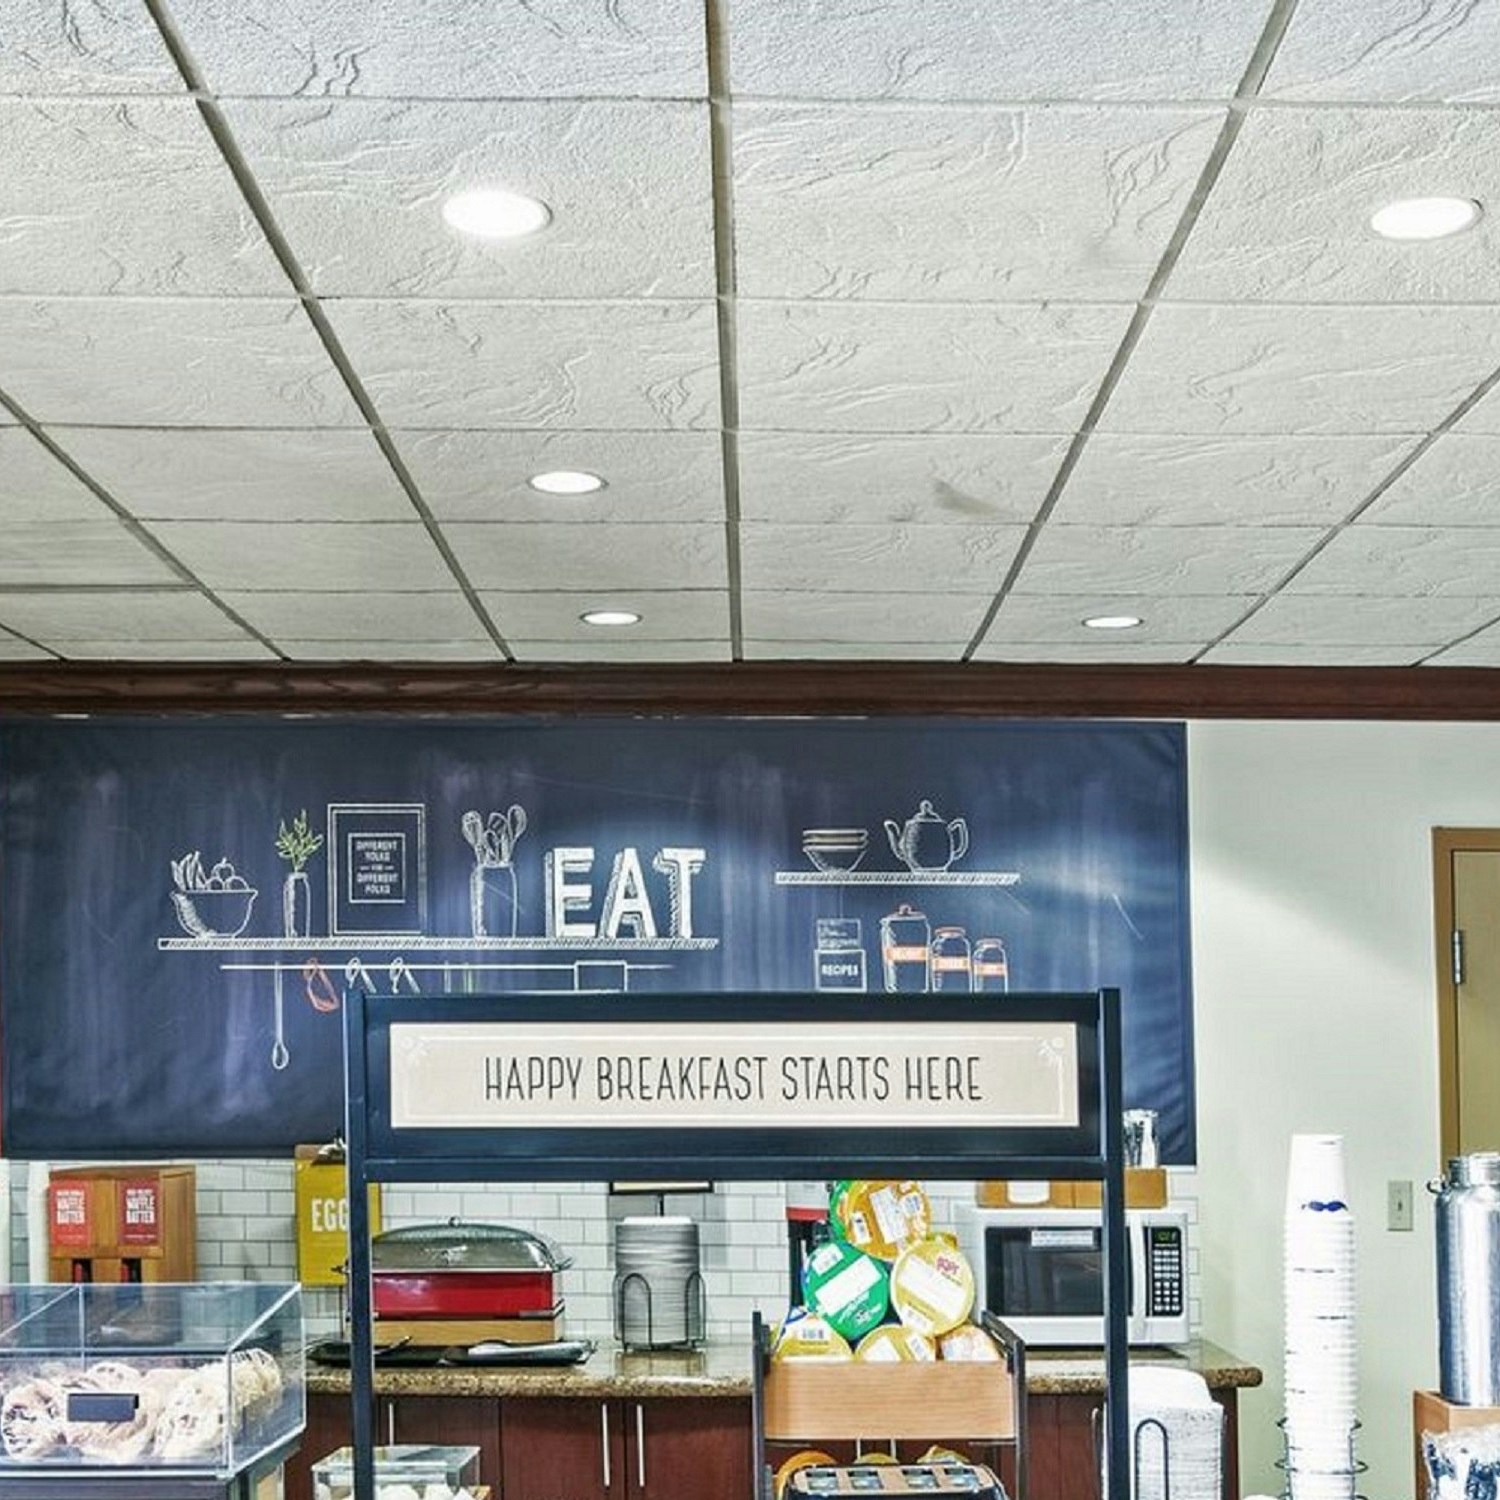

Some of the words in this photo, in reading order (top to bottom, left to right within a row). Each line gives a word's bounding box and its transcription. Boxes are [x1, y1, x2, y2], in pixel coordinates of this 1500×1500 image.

[545, 847, 707, 939] EAT
[821, 964, 859, 977] RECIPES
[484, 1056, 583, 1101] HAPPY
[597, 1056, 768, 1101] BREAKFAST
[781, 1056, 891, 1101] STARTS
[905, 1056, 984, 1101] HERE
[312, 1198, 349, 1232] EGG
